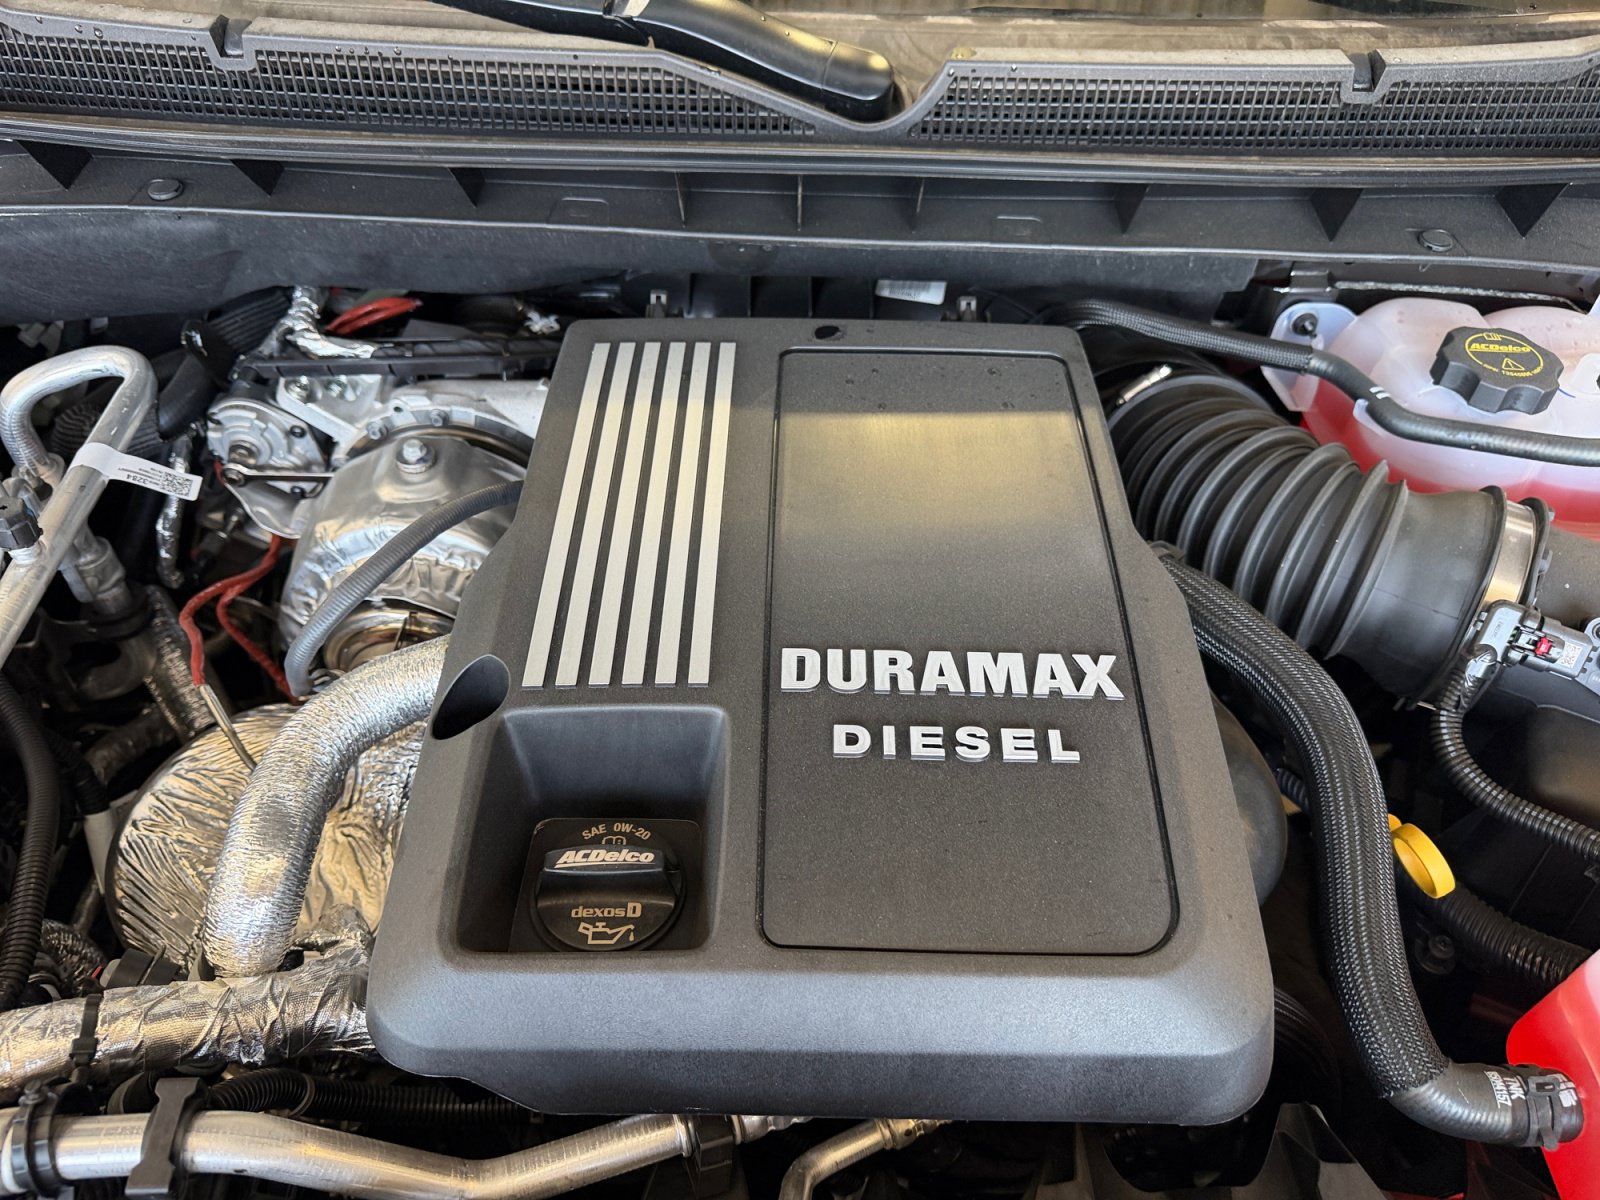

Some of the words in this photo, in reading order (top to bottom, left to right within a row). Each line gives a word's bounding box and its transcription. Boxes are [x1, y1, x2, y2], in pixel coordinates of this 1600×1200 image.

[780, 647, 1125, 701] DURAMAX
[832, 724, 1081, 763] DIESEL
[582, 823, 607, 840] SAE
[613, 822, 652, 840] 0W-20
[555, 848, 655, 866] ACDelco
